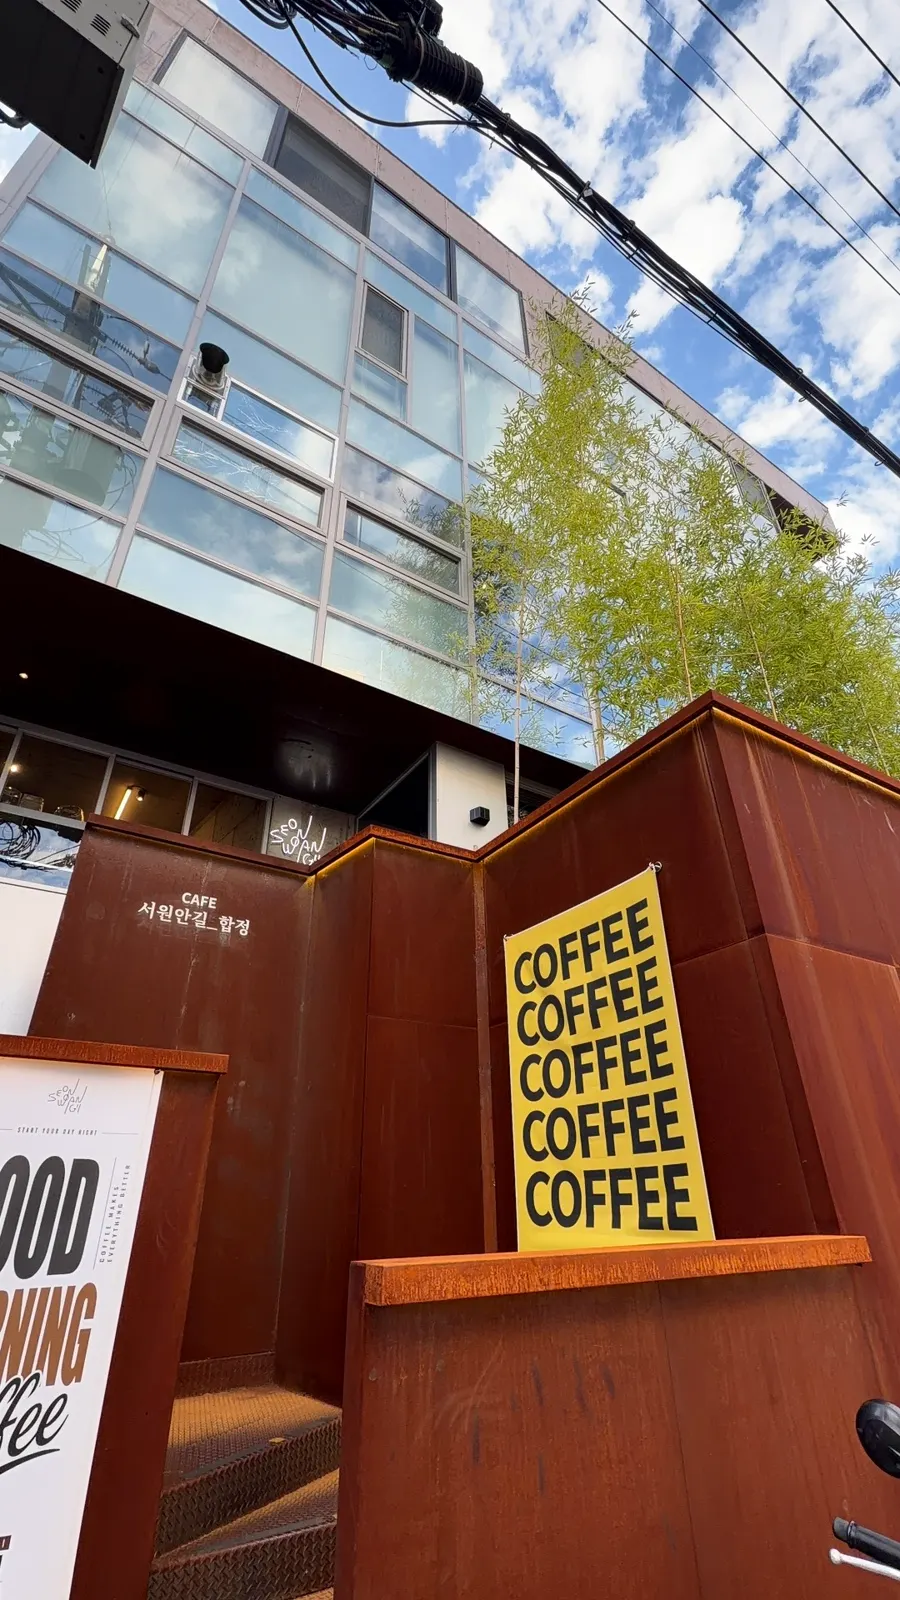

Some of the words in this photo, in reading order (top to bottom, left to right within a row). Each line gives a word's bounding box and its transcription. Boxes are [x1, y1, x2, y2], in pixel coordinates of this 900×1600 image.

[181, 892, 218, 909] CAFE
[514, 897, 655, 995] COFFEE
[517, 955, 664, 1046] COFFEE
[519, 1018, 675, 1102] COFFEE
[17, 1126, 39, 1134] START
[523, 1087, 686, 1162] COFFEE
[99, 1225, 112, 1263] COFFEE
[108, 1186, 119, 1218] MAKES
[107, 1203, 123, 1263] EVERYTHING
[119, 1164, 130, 1198] BETTER
[525, 1163, 698, 1232] COFFEE
